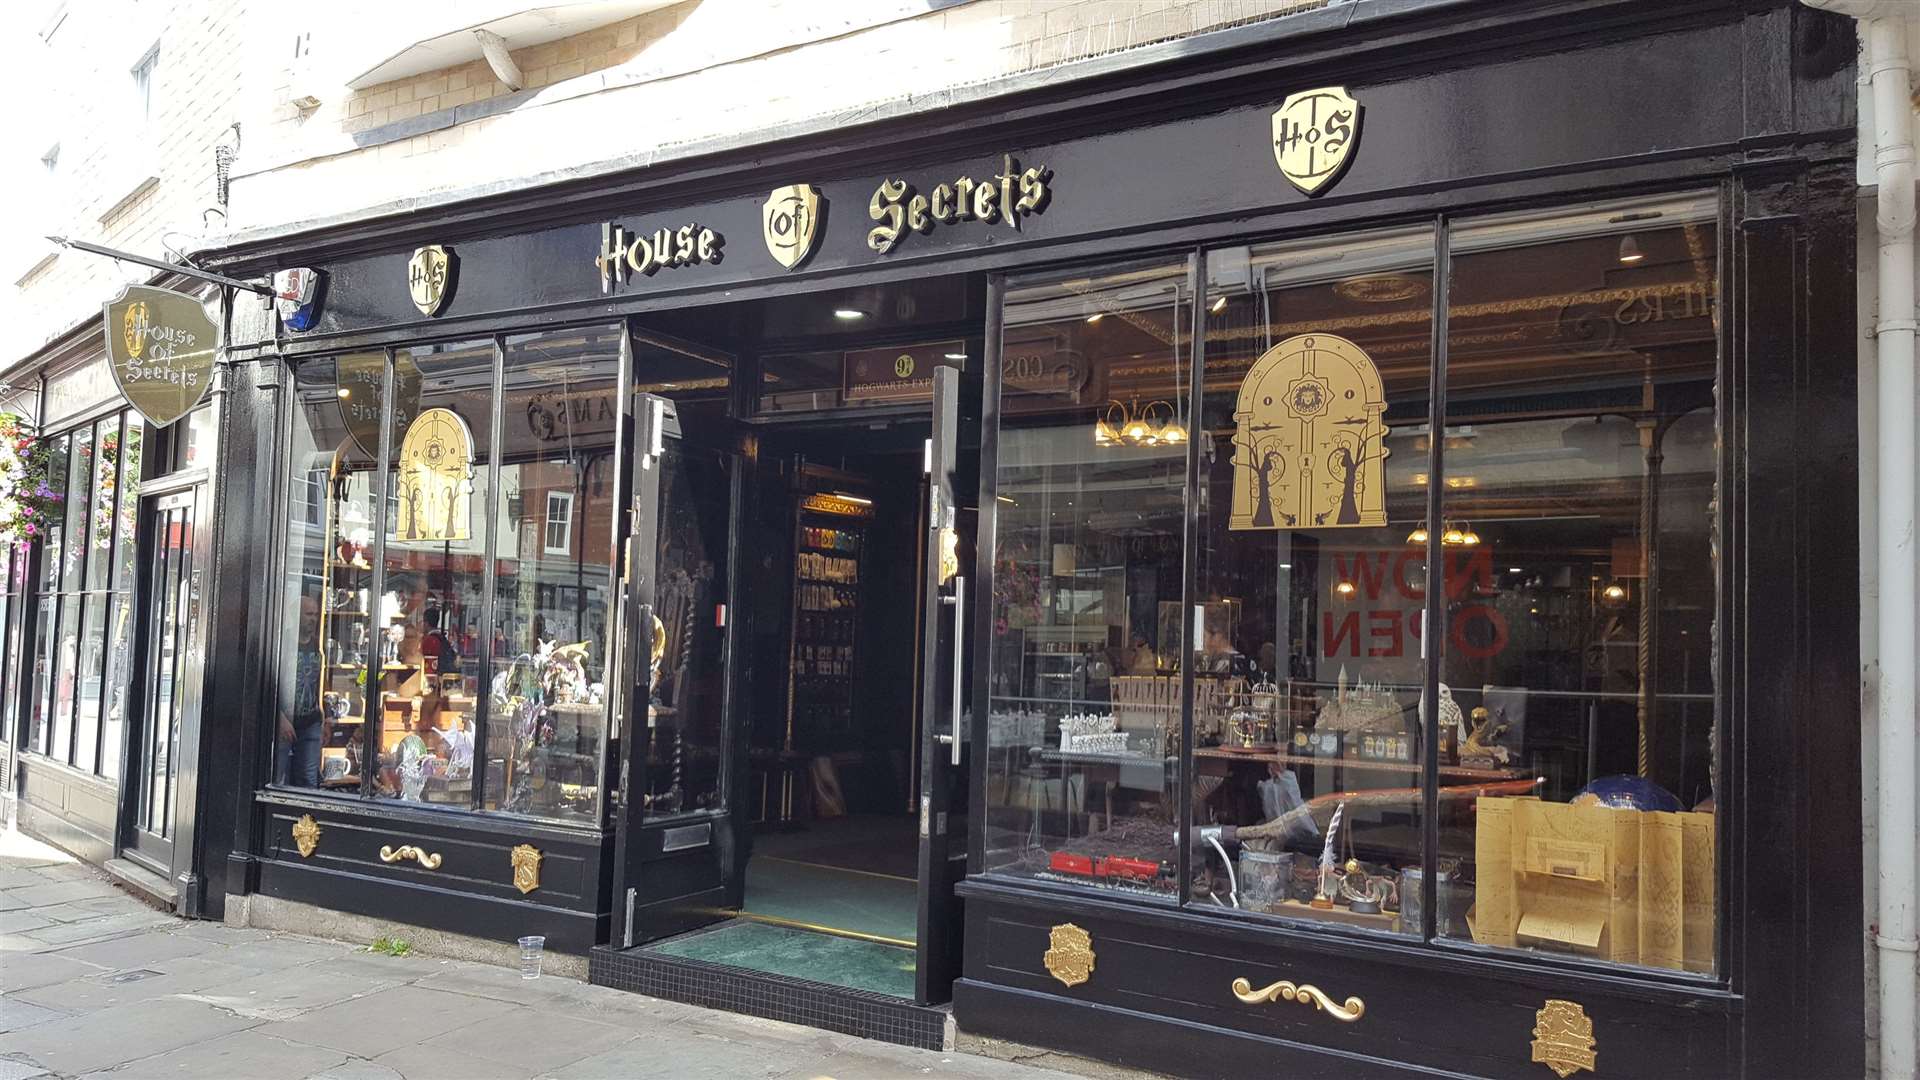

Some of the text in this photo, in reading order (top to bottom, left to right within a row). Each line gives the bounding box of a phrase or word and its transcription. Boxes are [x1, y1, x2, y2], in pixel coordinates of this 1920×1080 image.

[595, 222, 716, 294] House
[867, 153, 1047, 255] Secrets
[131, 306, 196, 347] House
[125, 357, 198, 389] Secrets
[854, 380, 908, 393] HOGWARTS
